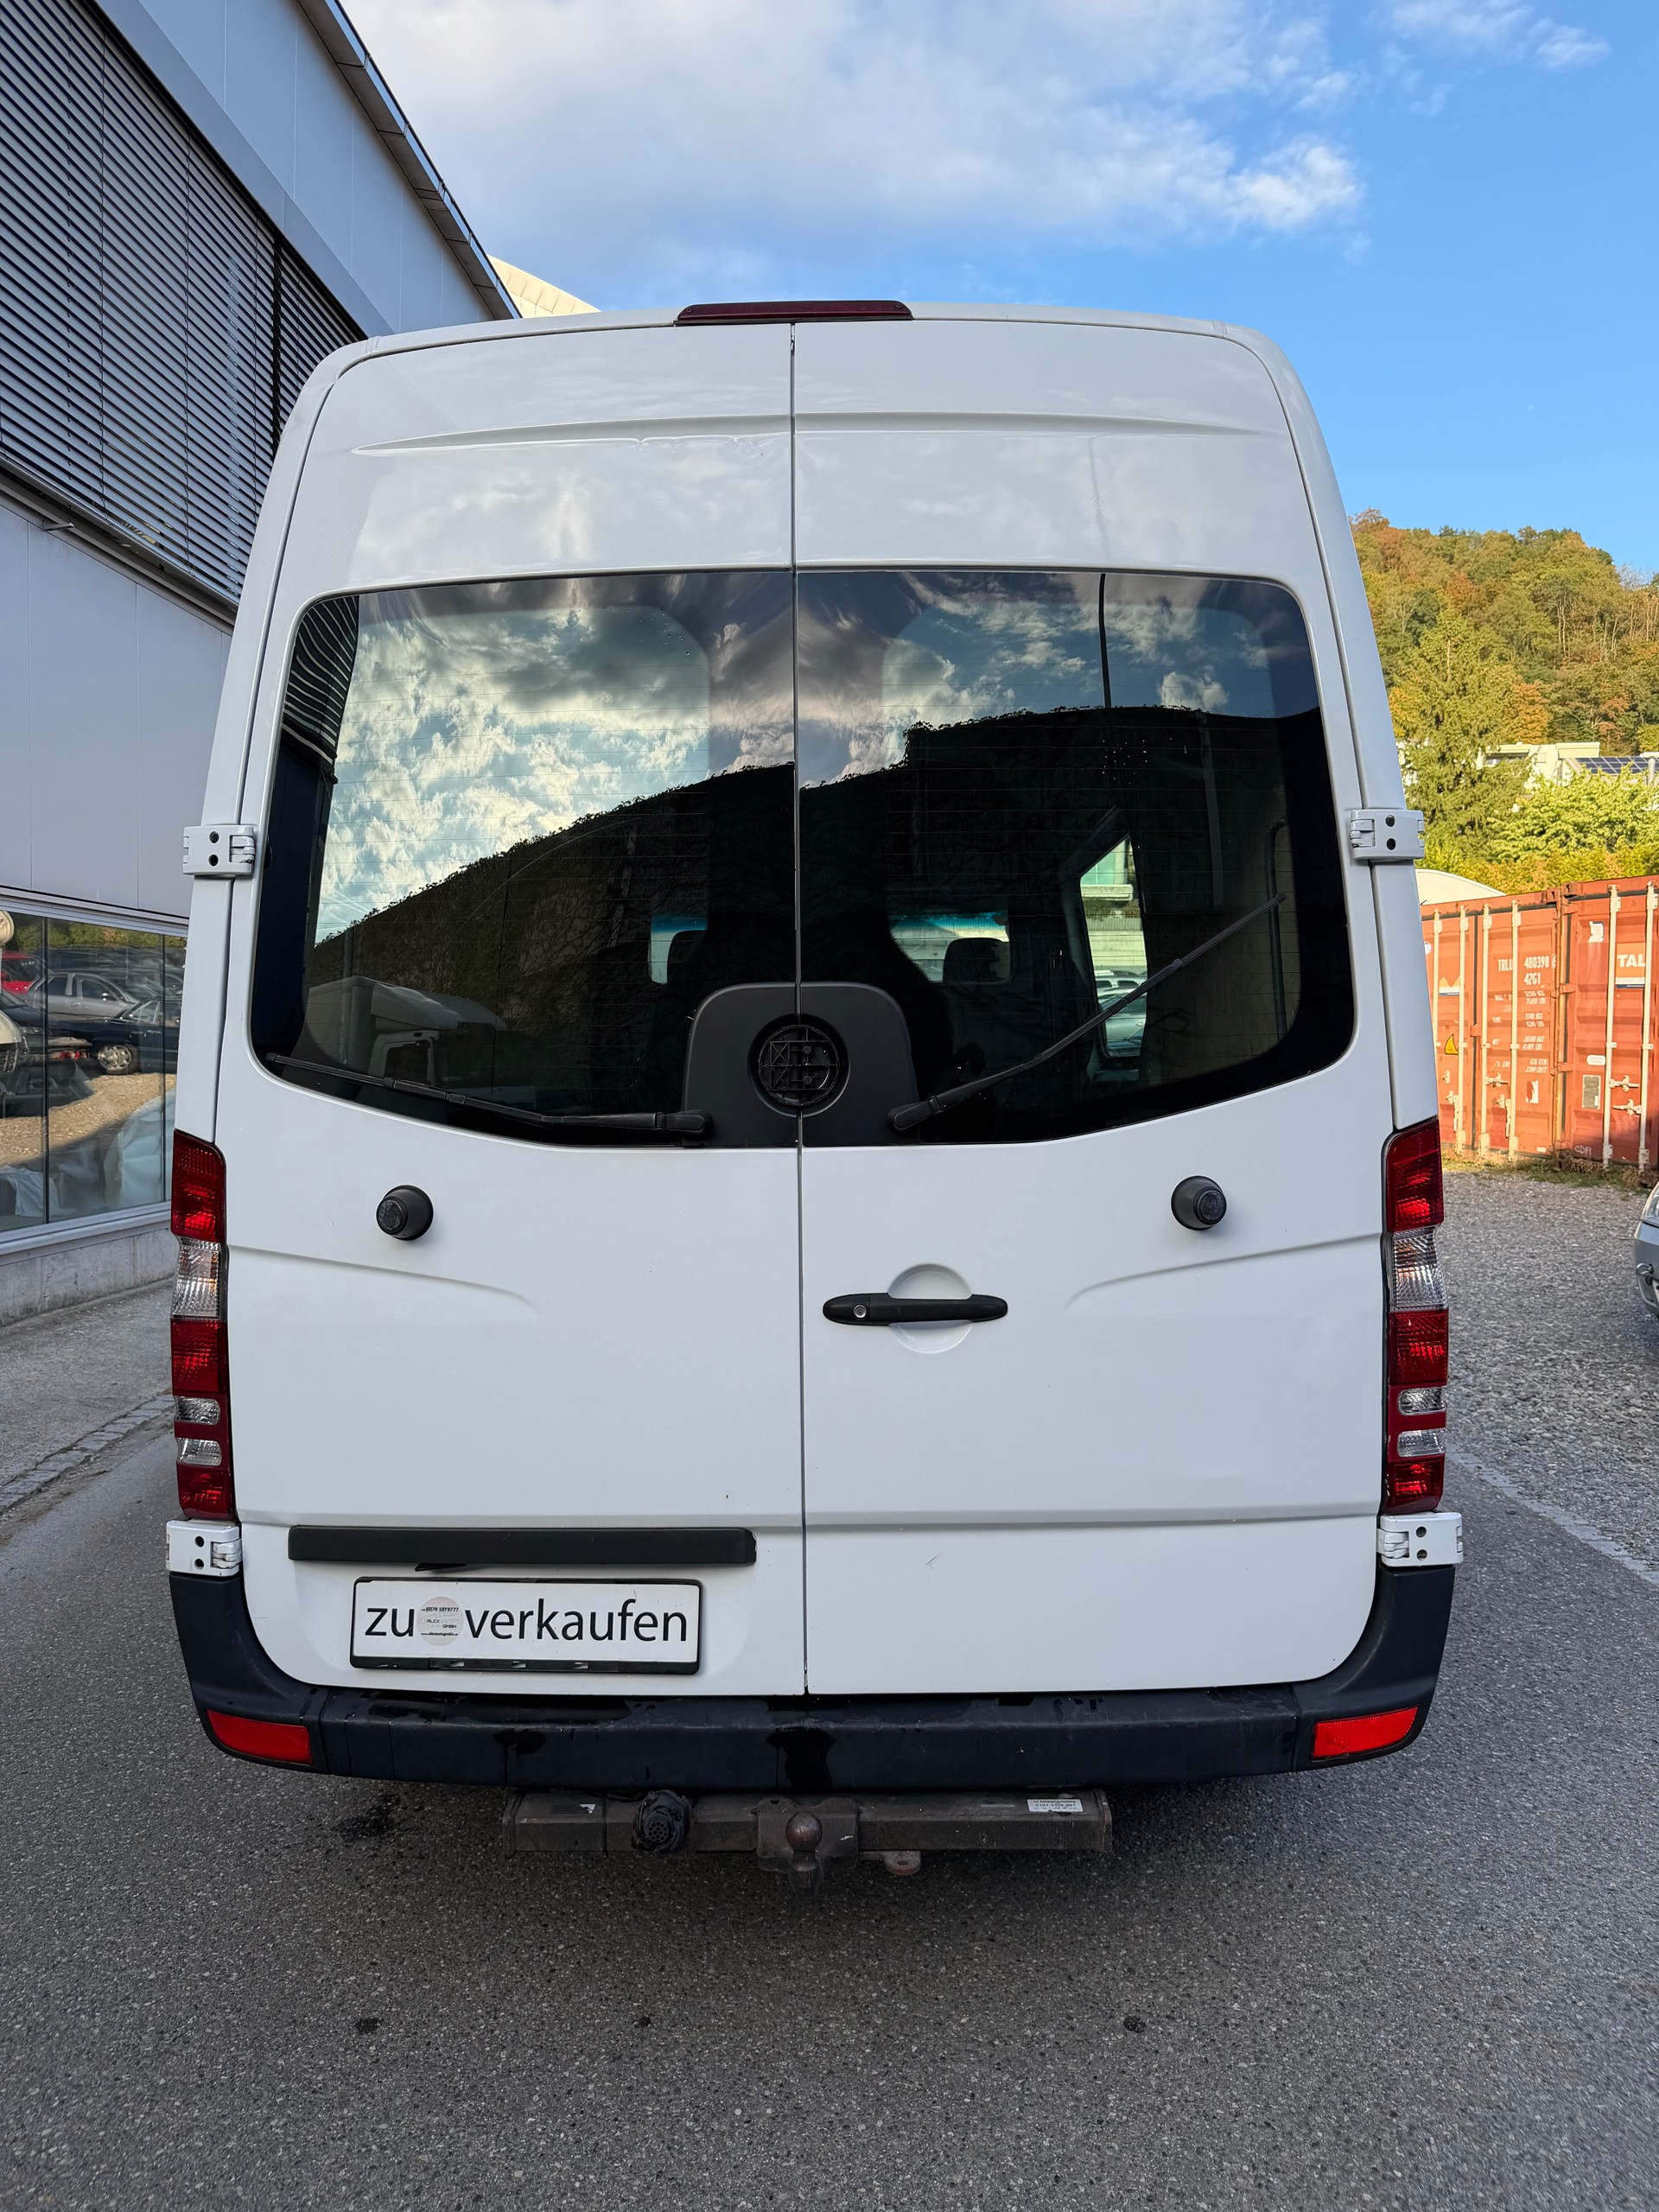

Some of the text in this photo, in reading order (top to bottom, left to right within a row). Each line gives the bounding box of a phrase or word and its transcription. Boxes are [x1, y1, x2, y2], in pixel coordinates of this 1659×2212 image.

[1524, 955, 1549, 969] 480398
[1618, 953, 1646, 968] TAL
[1523, 972, 1541, 986] 42G1
[364, 1598, 688, 1642] zu verkaufen
